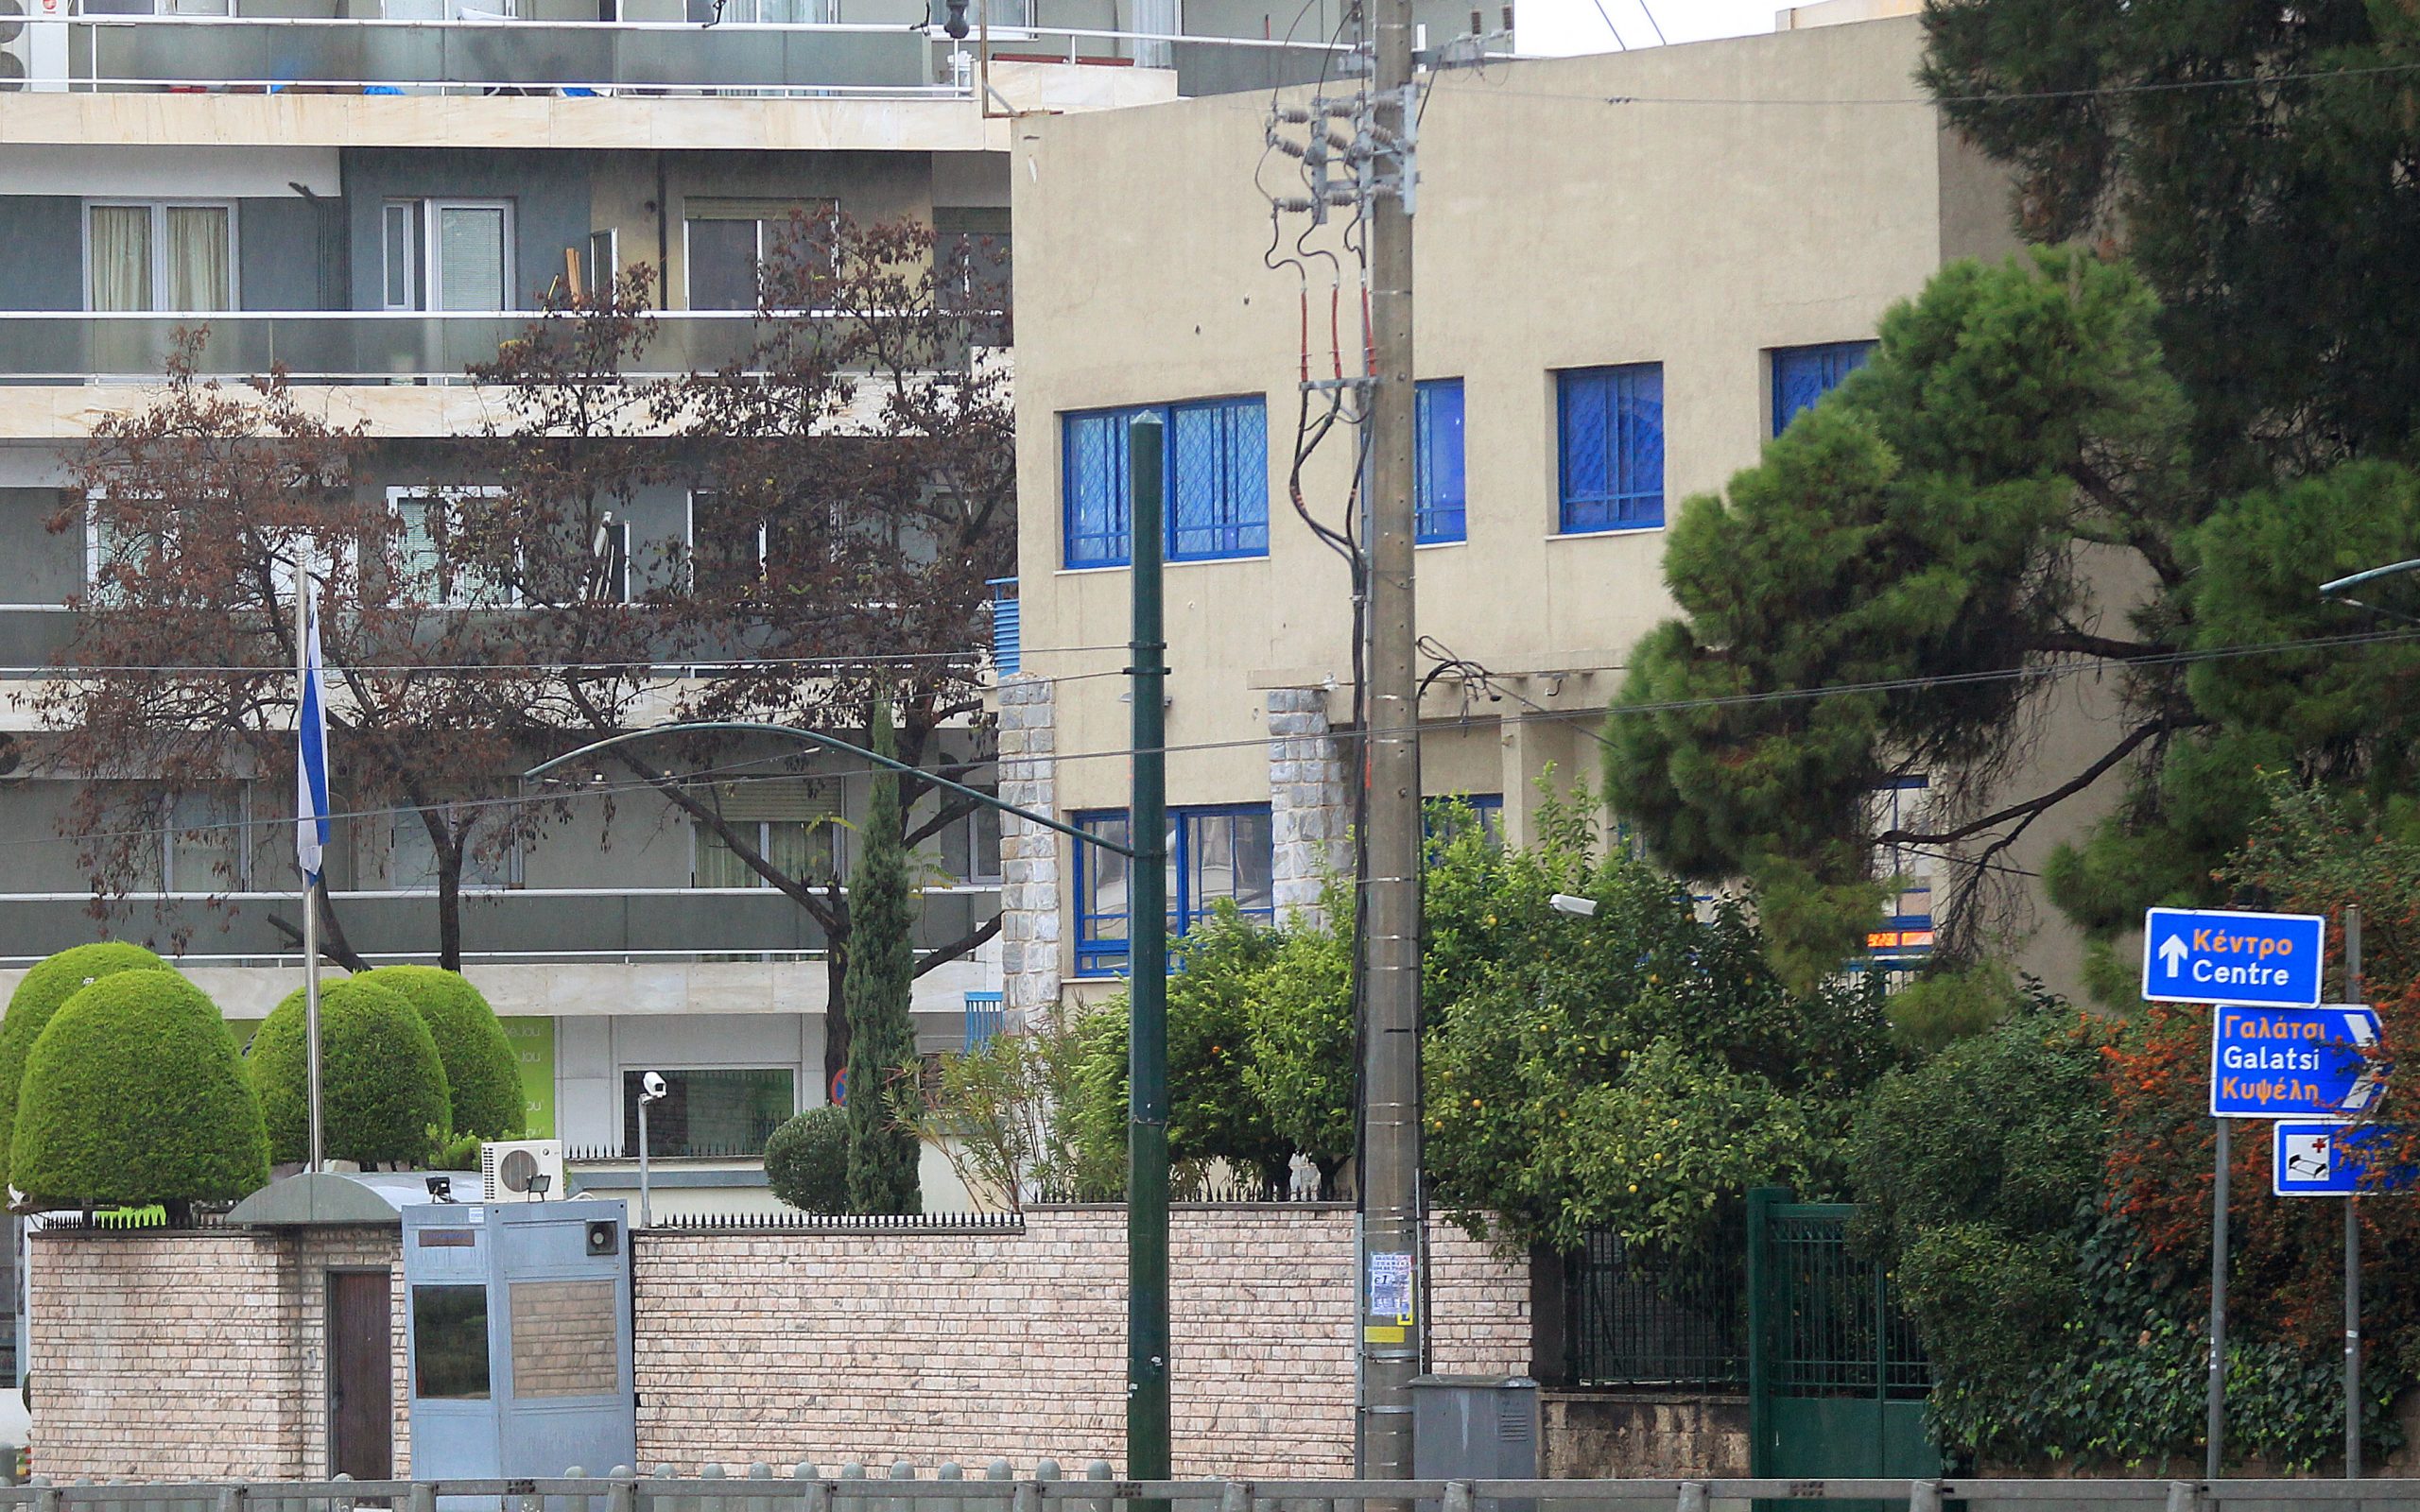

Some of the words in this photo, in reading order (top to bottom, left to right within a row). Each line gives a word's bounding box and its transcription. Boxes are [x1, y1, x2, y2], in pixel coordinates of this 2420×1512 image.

[2193, 928, 2293, 960] Κέντρο
[2192, 959, 2290, 986] Centre
[2225, 1015, 2325, 1040] Γαλάτσι
[2223, 1045, 2320, 1071] Galatsi
[2221, 1076, 2320, 1106] Κυψέλη
